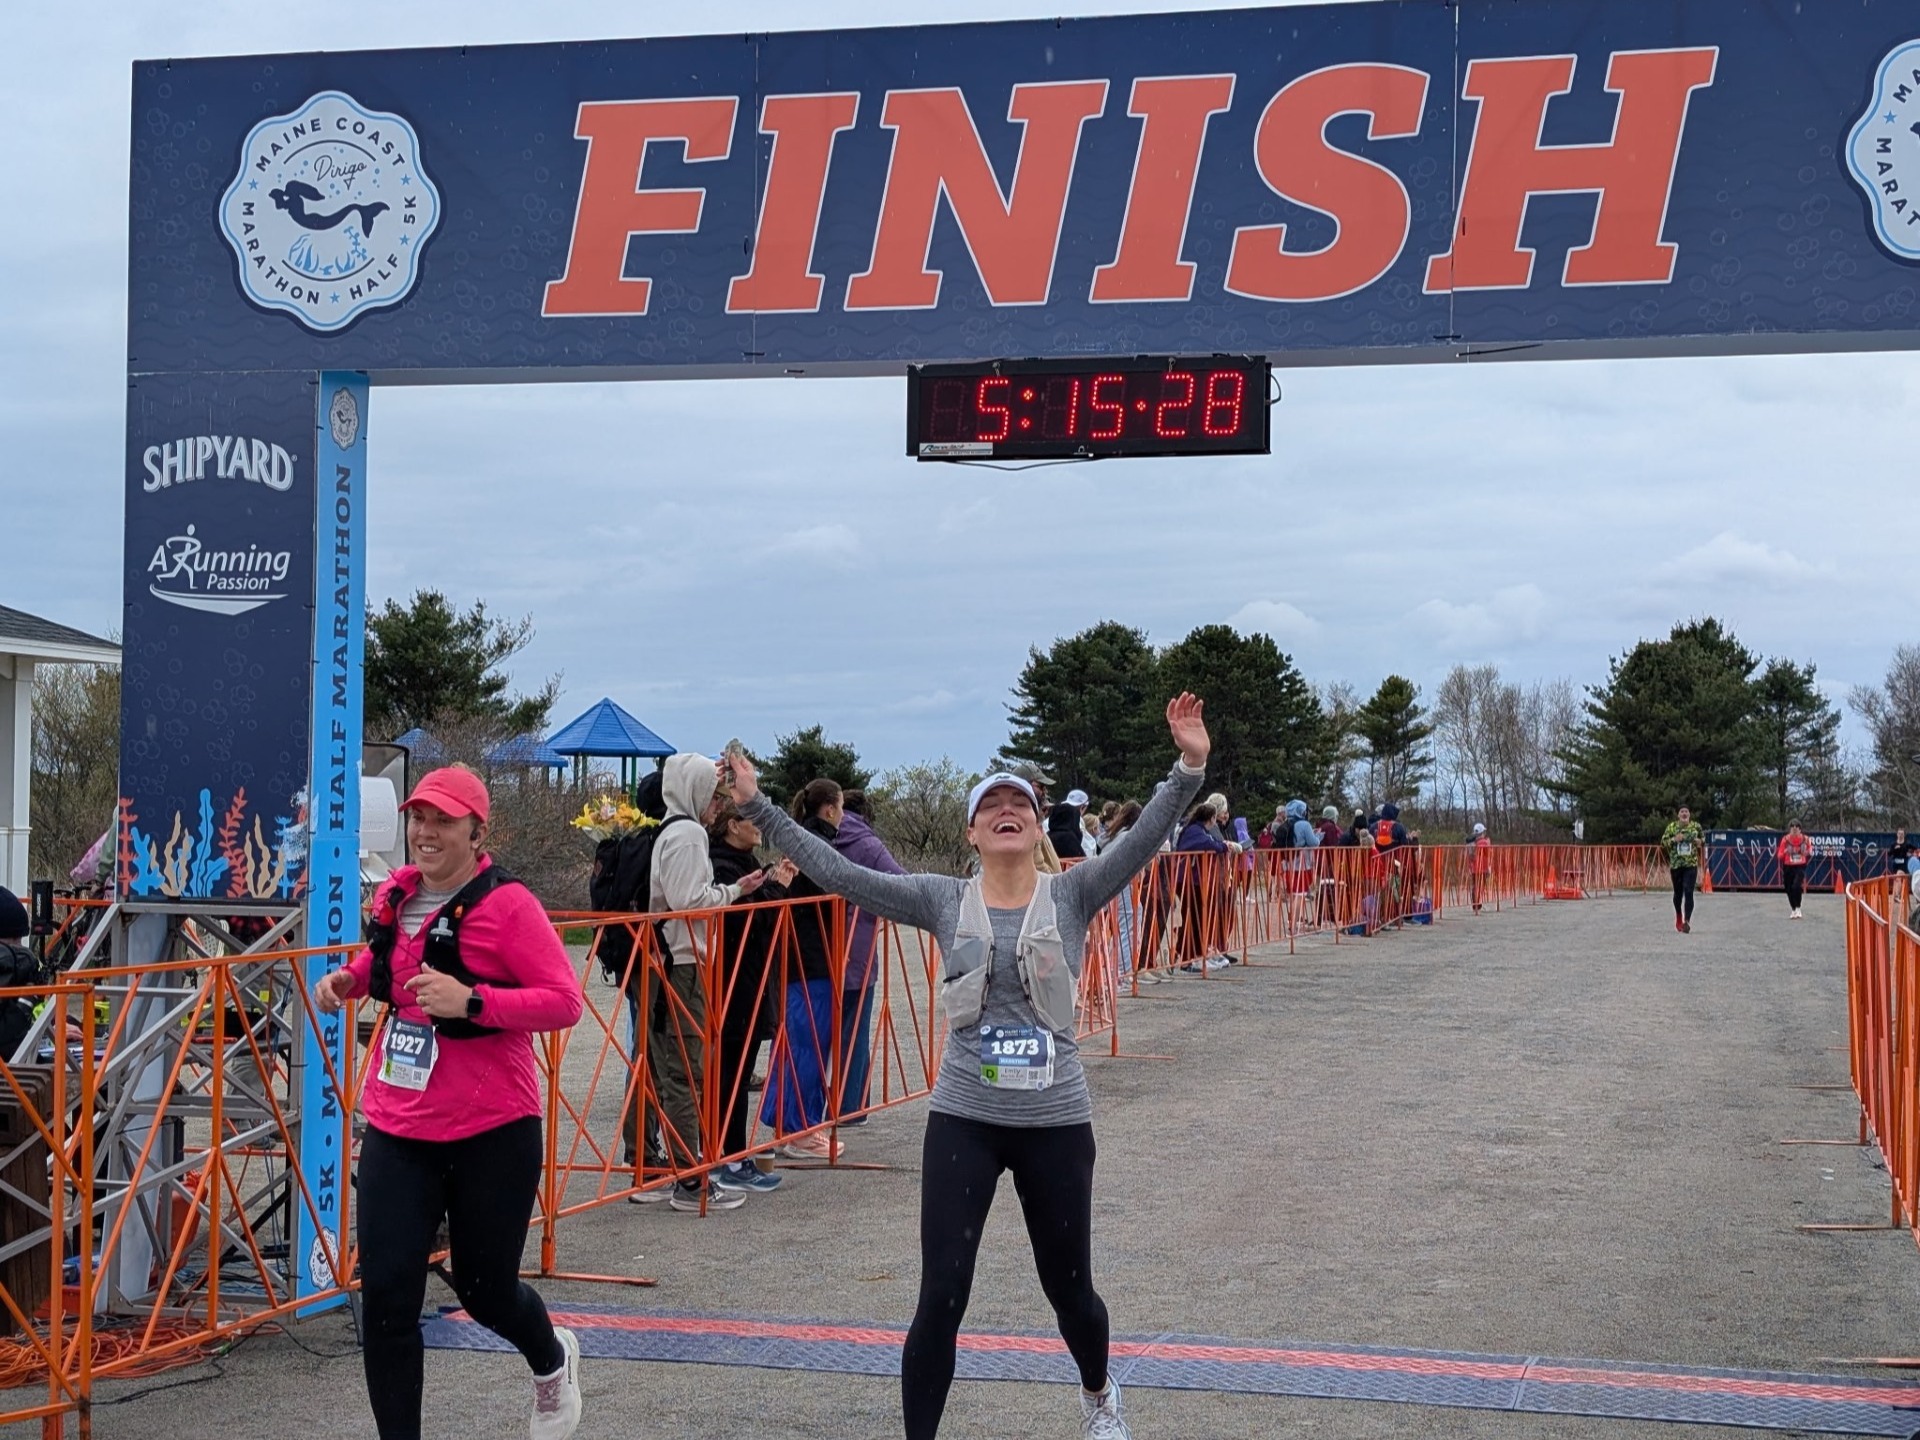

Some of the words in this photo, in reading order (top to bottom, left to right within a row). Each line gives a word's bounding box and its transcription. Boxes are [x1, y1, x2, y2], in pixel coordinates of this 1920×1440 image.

[256, 118, 321, 172] MAINE
[336, 117, 405, 167] COAST
[314, 155, 367, 191] Dirigo
[540, 46, 1719, 318] FINISH
[1876, 137, 1920, 226] MARAT
[404, 196, 416, 225] 5K
[243, 202, 320, 305] MARATHON
[349, 254, 399, 300] HALF
[147, 545, 168, 572] A
[156, 524, 290, 589] Running
[207, 573, 269, 591] Passion
[332, 464, 351, 709] MARATHON
[329, 719, 347, 832] HALF
[1809, 836, 1846, 846] ROIANO
[390, 1032, 426, 1055] 1927
[991, 1038, 1039, 1055] 1873
[986, 1069, 995, 1079] D
[319, 1160, 335, 1212] 5K
